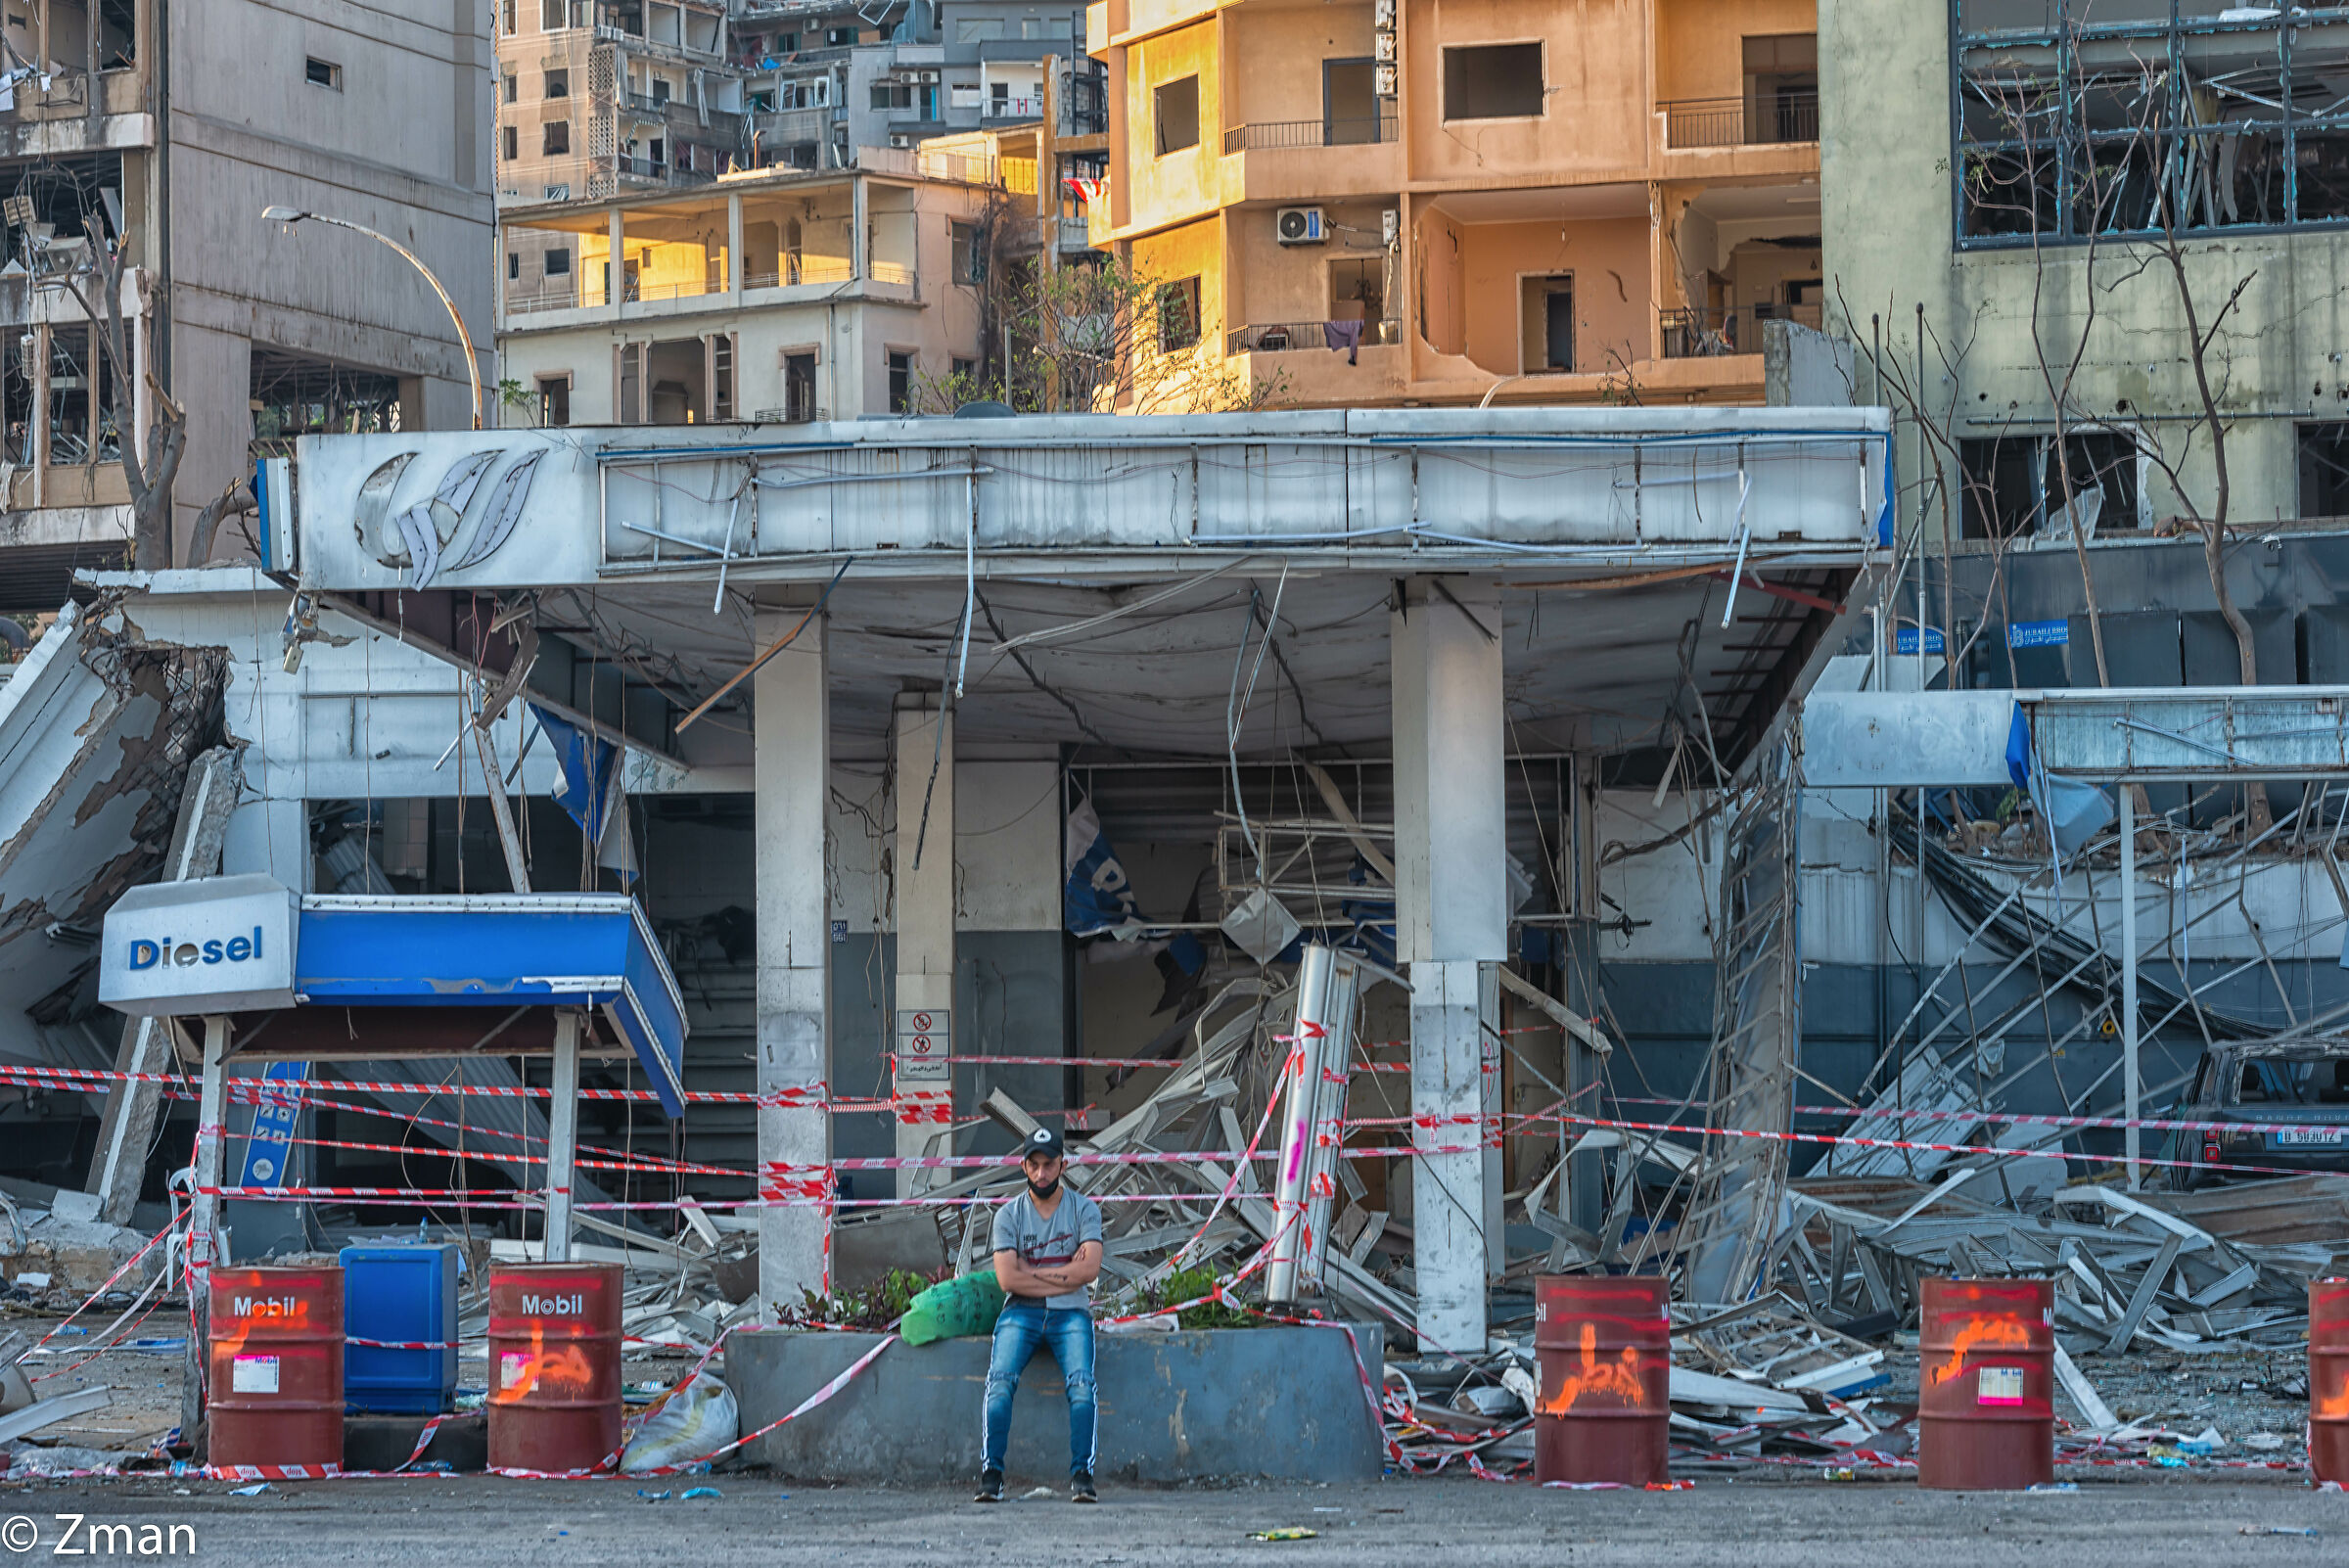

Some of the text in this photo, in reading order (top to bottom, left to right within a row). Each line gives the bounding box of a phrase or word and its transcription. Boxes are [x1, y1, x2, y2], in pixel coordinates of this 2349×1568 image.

[129, 925, 262, 971] Diesel
[235, 1296, 296, 1317] Mobil
[523, 1294, 582, 1315] Mobil
